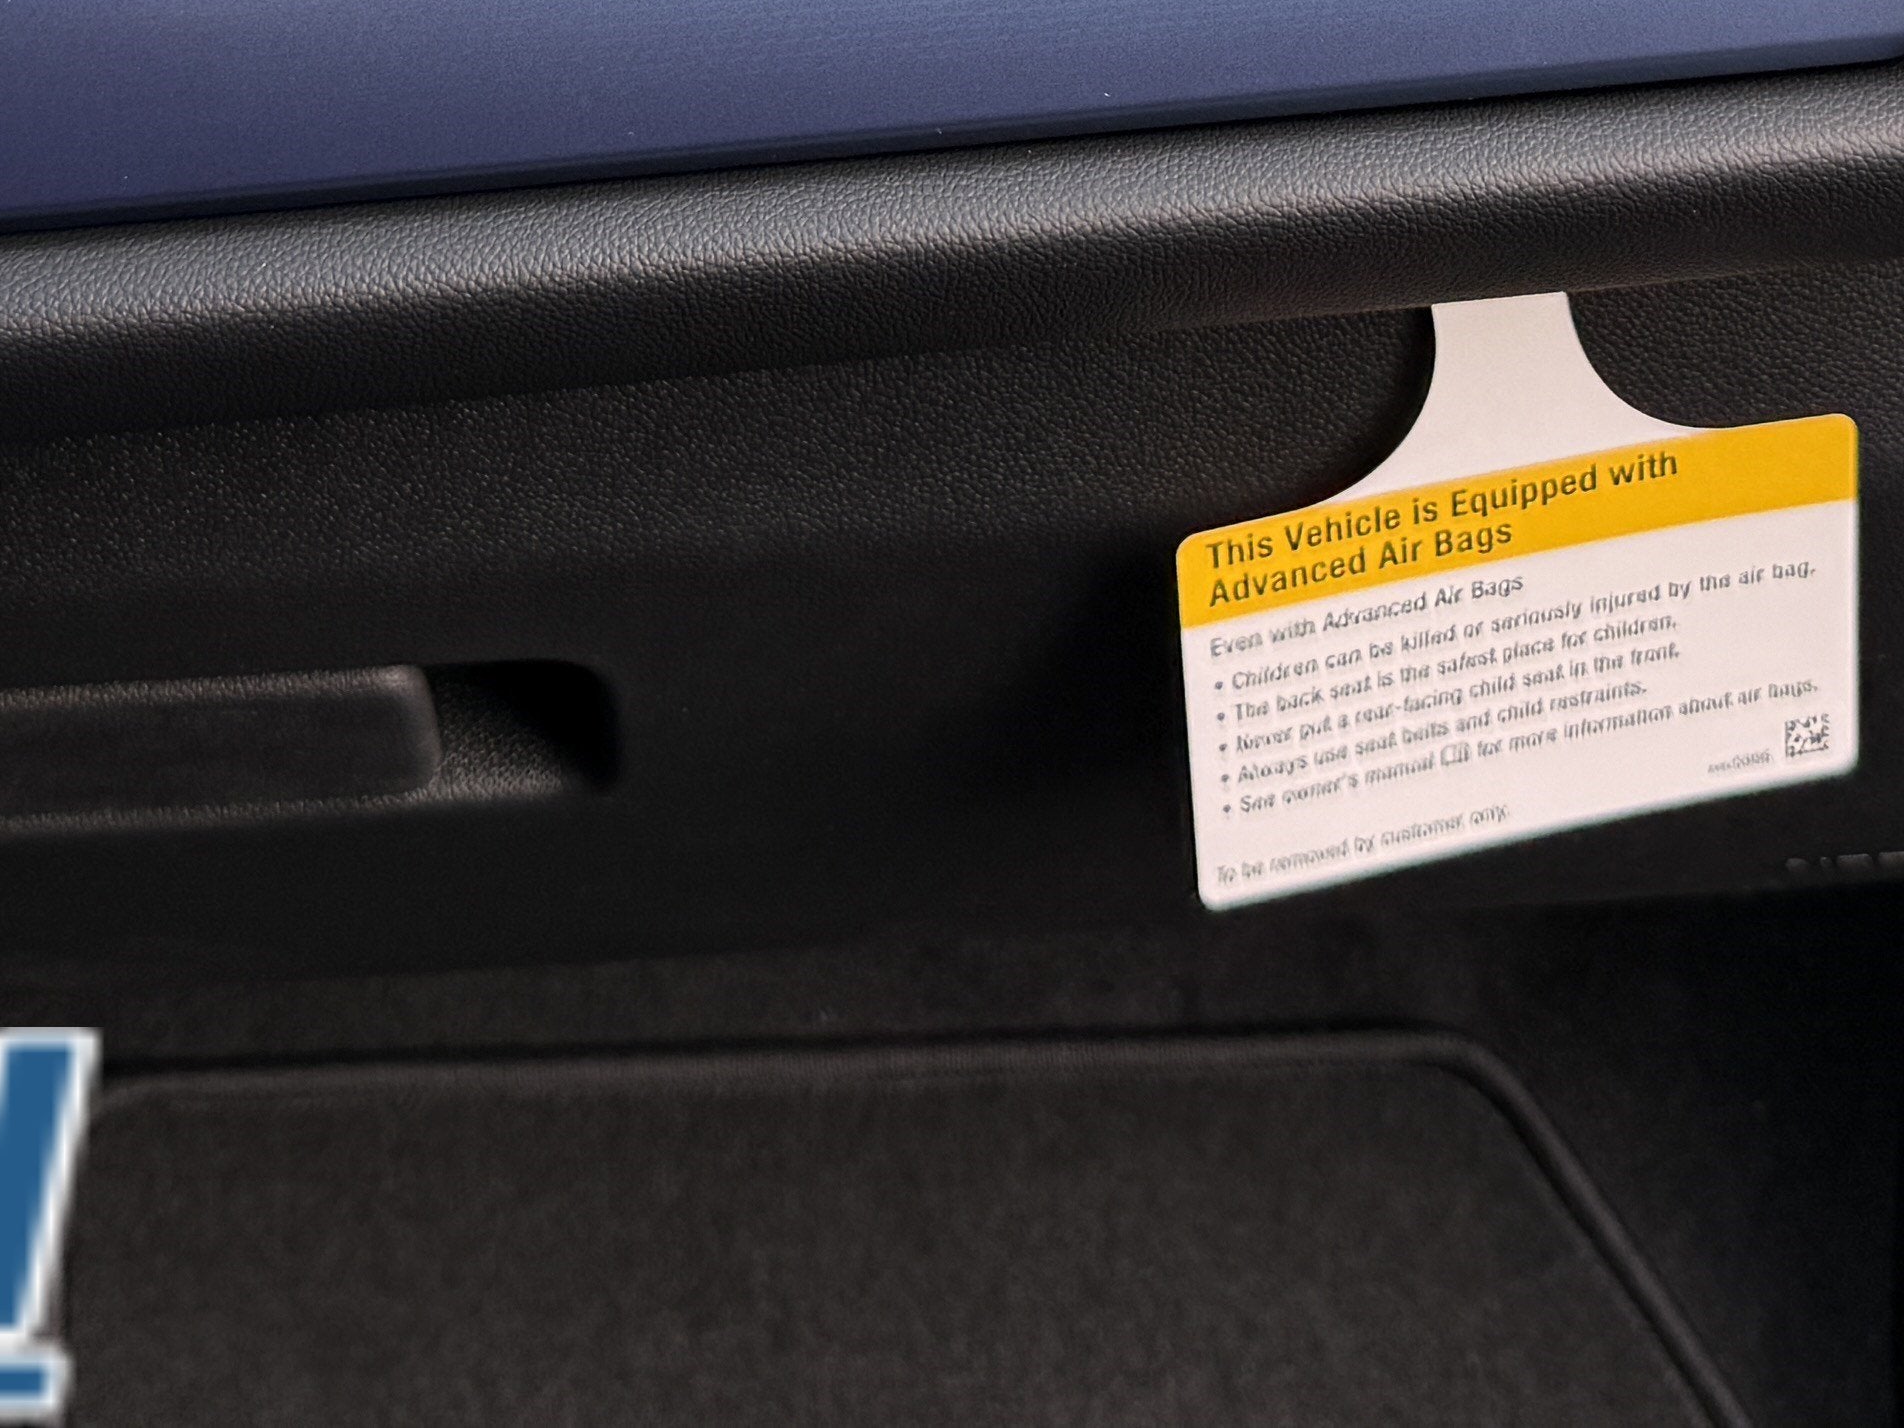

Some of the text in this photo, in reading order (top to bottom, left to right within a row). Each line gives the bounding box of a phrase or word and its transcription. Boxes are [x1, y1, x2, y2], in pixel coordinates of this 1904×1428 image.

[1206, 451, 1678, 569] This Vehicle is Equipped with
[1208, 523, 1513, 608] Advanced Air Bags
[1210, 576, 1525, 658] Even with Advanced Air Bags
[1232, 561, 1816, 690] Children can be killed or seriously injured by the air bag.
[1235, 614, 1678, 722] The back seat is the safest place for children.
[1236, 642, 1680, 753] Never put a rear-facing child seat in the front.
[1238, 681, 1647, 784] Always use seat belts and child restraints.
[1240, 793, 1277, 813] See
[1282, 773, 1359, 805] owner's
[1365, 750, 1435, 786] manual
[1477, 738, 1504, 757] for
[1508, 728, 1558, 752] more
[1563, 704, 1675, 740] information
[1678, 691, 1734, 716] about
[1737, 686, 1763, 706] air
